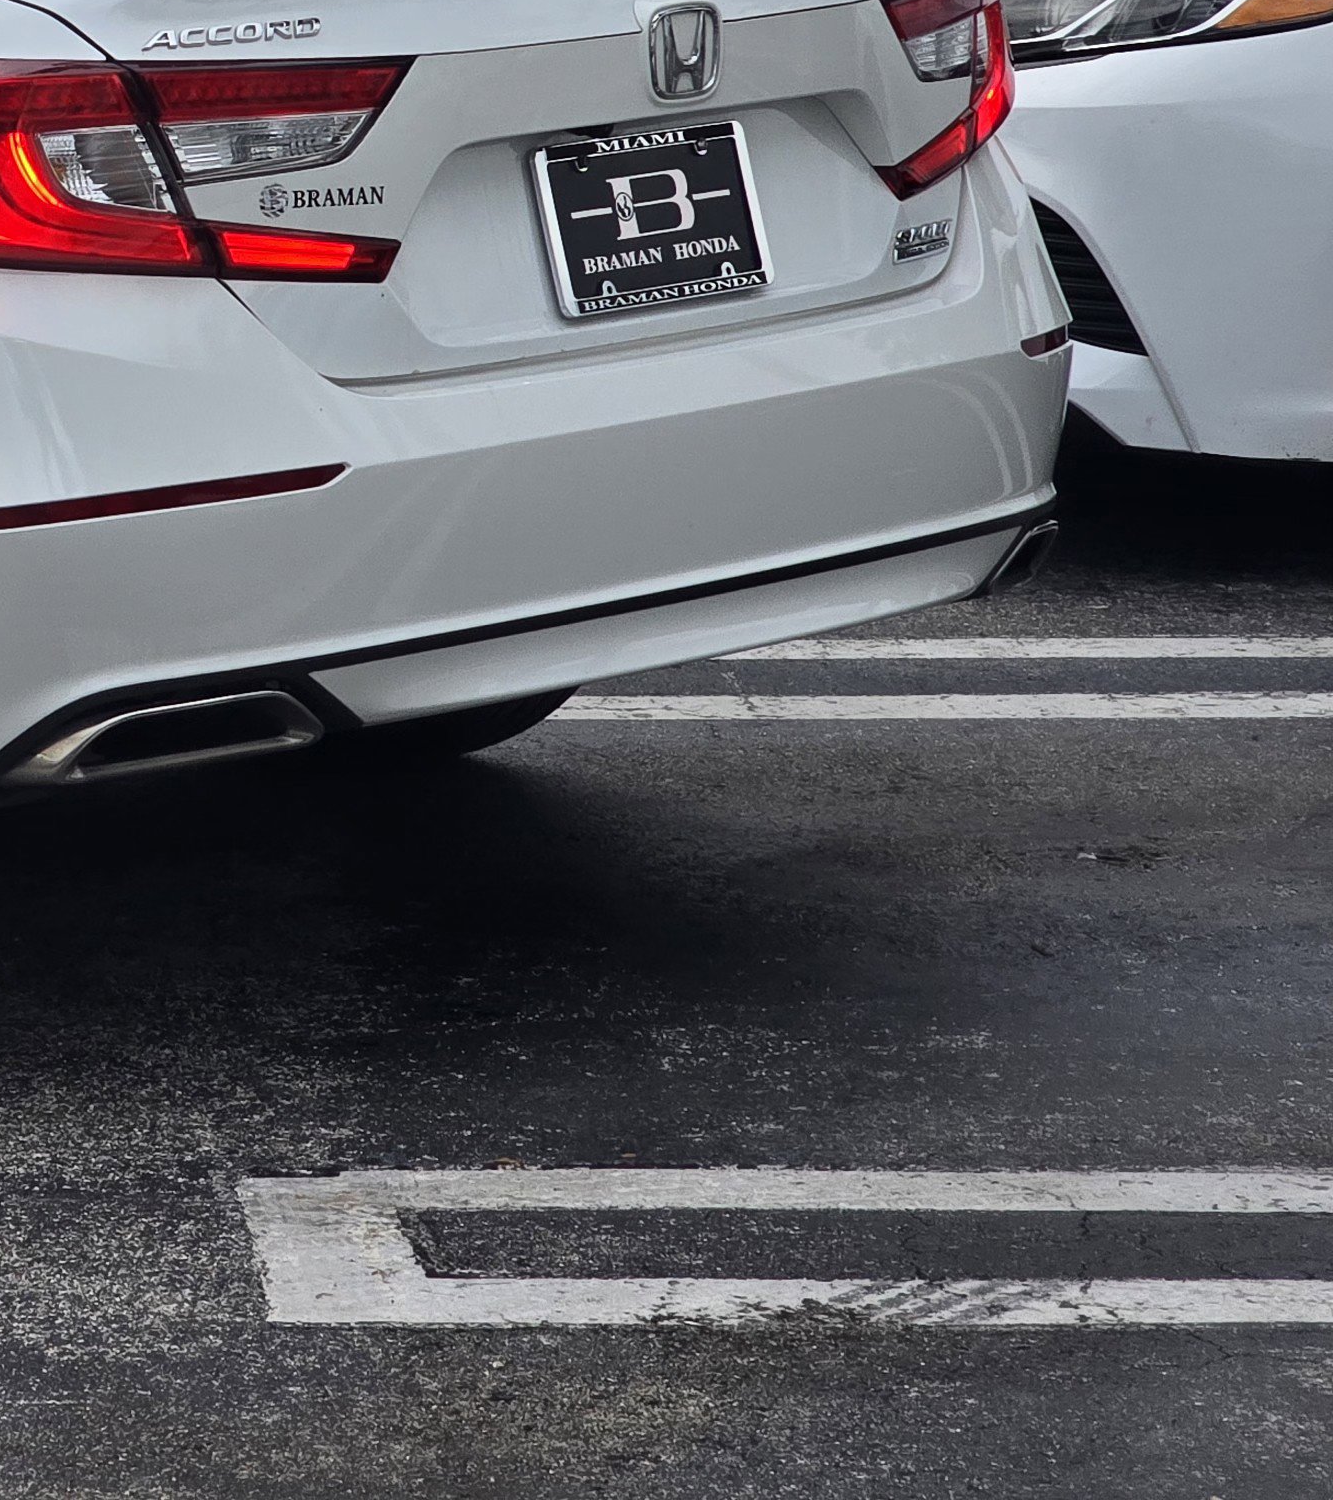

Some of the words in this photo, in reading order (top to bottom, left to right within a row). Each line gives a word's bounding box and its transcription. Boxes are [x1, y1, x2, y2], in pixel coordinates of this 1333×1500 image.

[141, 17, 322, 52] ACCORD
[595, 130, 686, 153] MIAMI
[292, 186, 385, 208] BRAMAN
[583, 246, 663, 274] BRAMAN
[673, 235, 741, 260] HONDA
[583, 286, 681, 311] BRAMAN
[683, 274, 763, 295] HONDA
